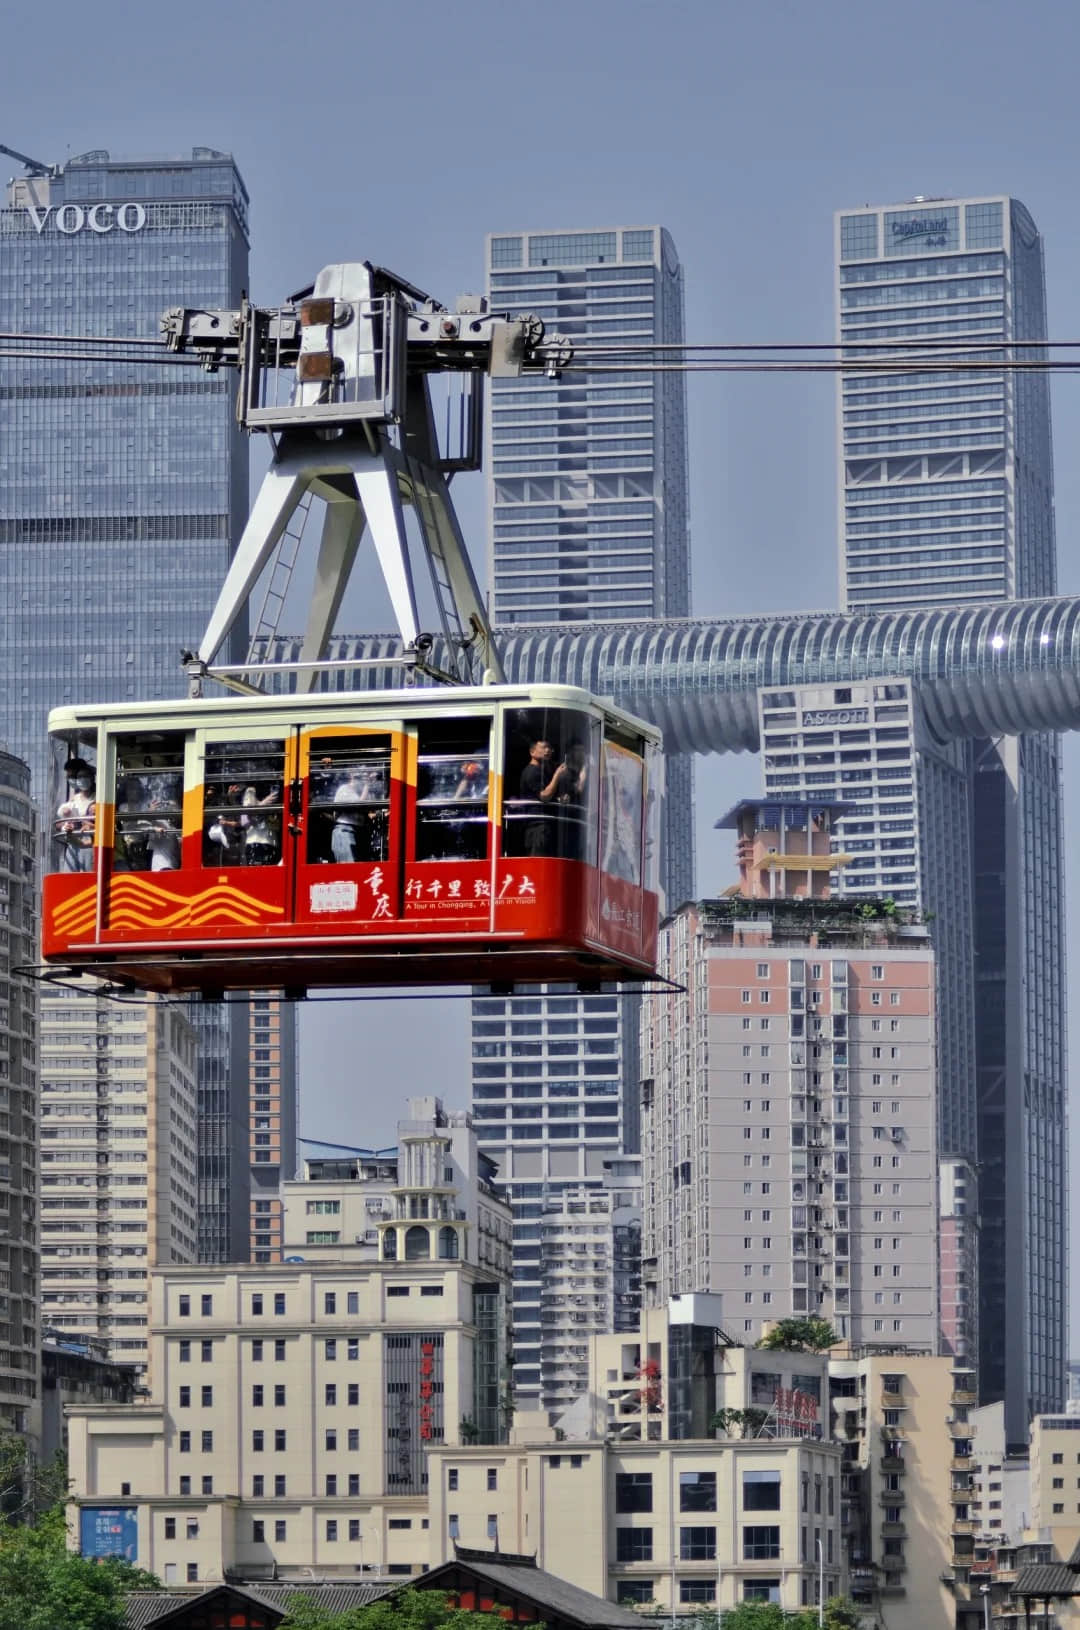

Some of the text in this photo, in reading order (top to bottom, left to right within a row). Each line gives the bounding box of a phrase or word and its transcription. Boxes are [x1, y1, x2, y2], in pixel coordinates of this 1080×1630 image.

[363, 866, 393, 919] 重庆
[405, 873, 536, 899] 行千里 致广大
[414, 902, 427, 910] Tour
